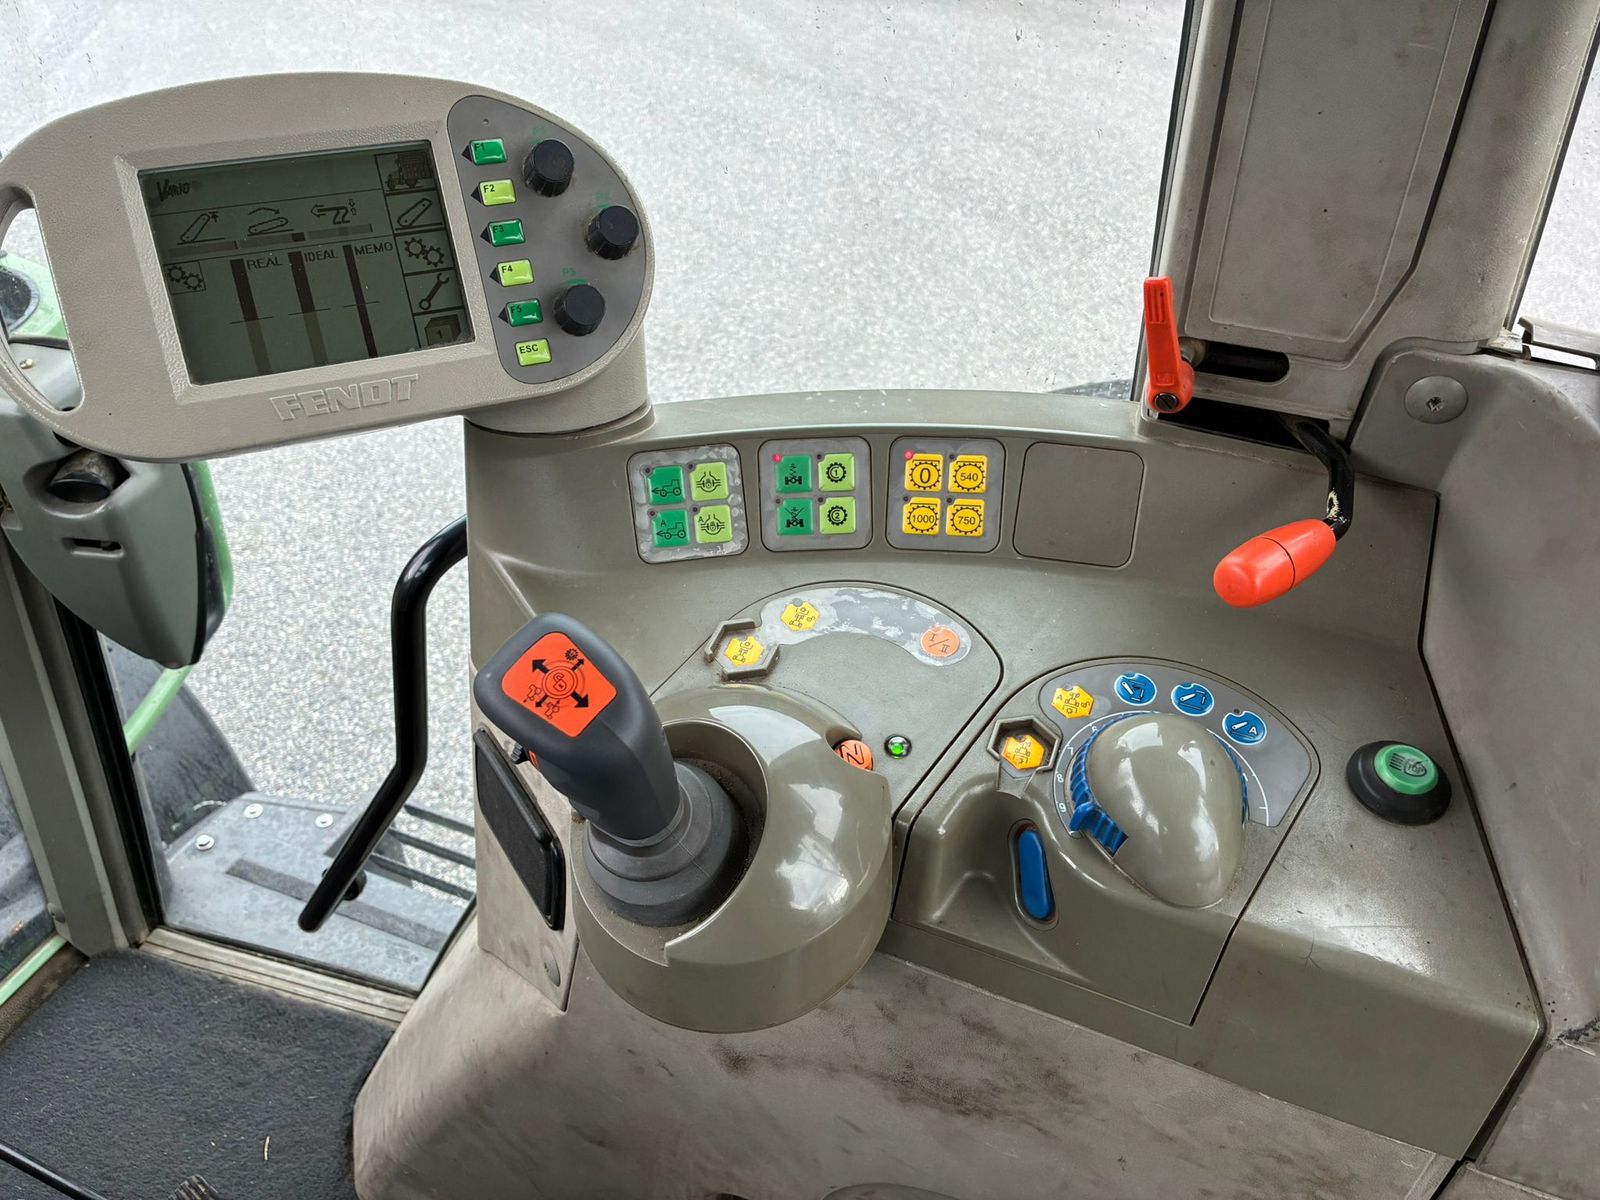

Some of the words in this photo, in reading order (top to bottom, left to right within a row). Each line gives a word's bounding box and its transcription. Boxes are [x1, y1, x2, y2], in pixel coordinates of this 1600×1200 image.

[474, 143, 485, 151] F1
[483, 184, 495, 193] F2
[493, 225, 504, 233] F3
[355, 241, 393, 256] MEMO
[304, 249, 338, 263] IDEAL
[247, 256, 282, 270] REAL
[501, 264, 513, 273] F4
[510, 305, 522, 314] F5
[519, 343, 539, 354] ESC
[270, 373, 418, 421] FENDT
[920, 467, 931, 484] 0
[960, 472, 978, 482] 540
[661, 519, 667, 527] A
[912, 514, 935, 524] 1000
[958, 516, 976, 526] 750
[1248, 726, 1258, 735] A
[1056, 773, 1064, 783] 8
[1058, 802, 1067, 813] 9
